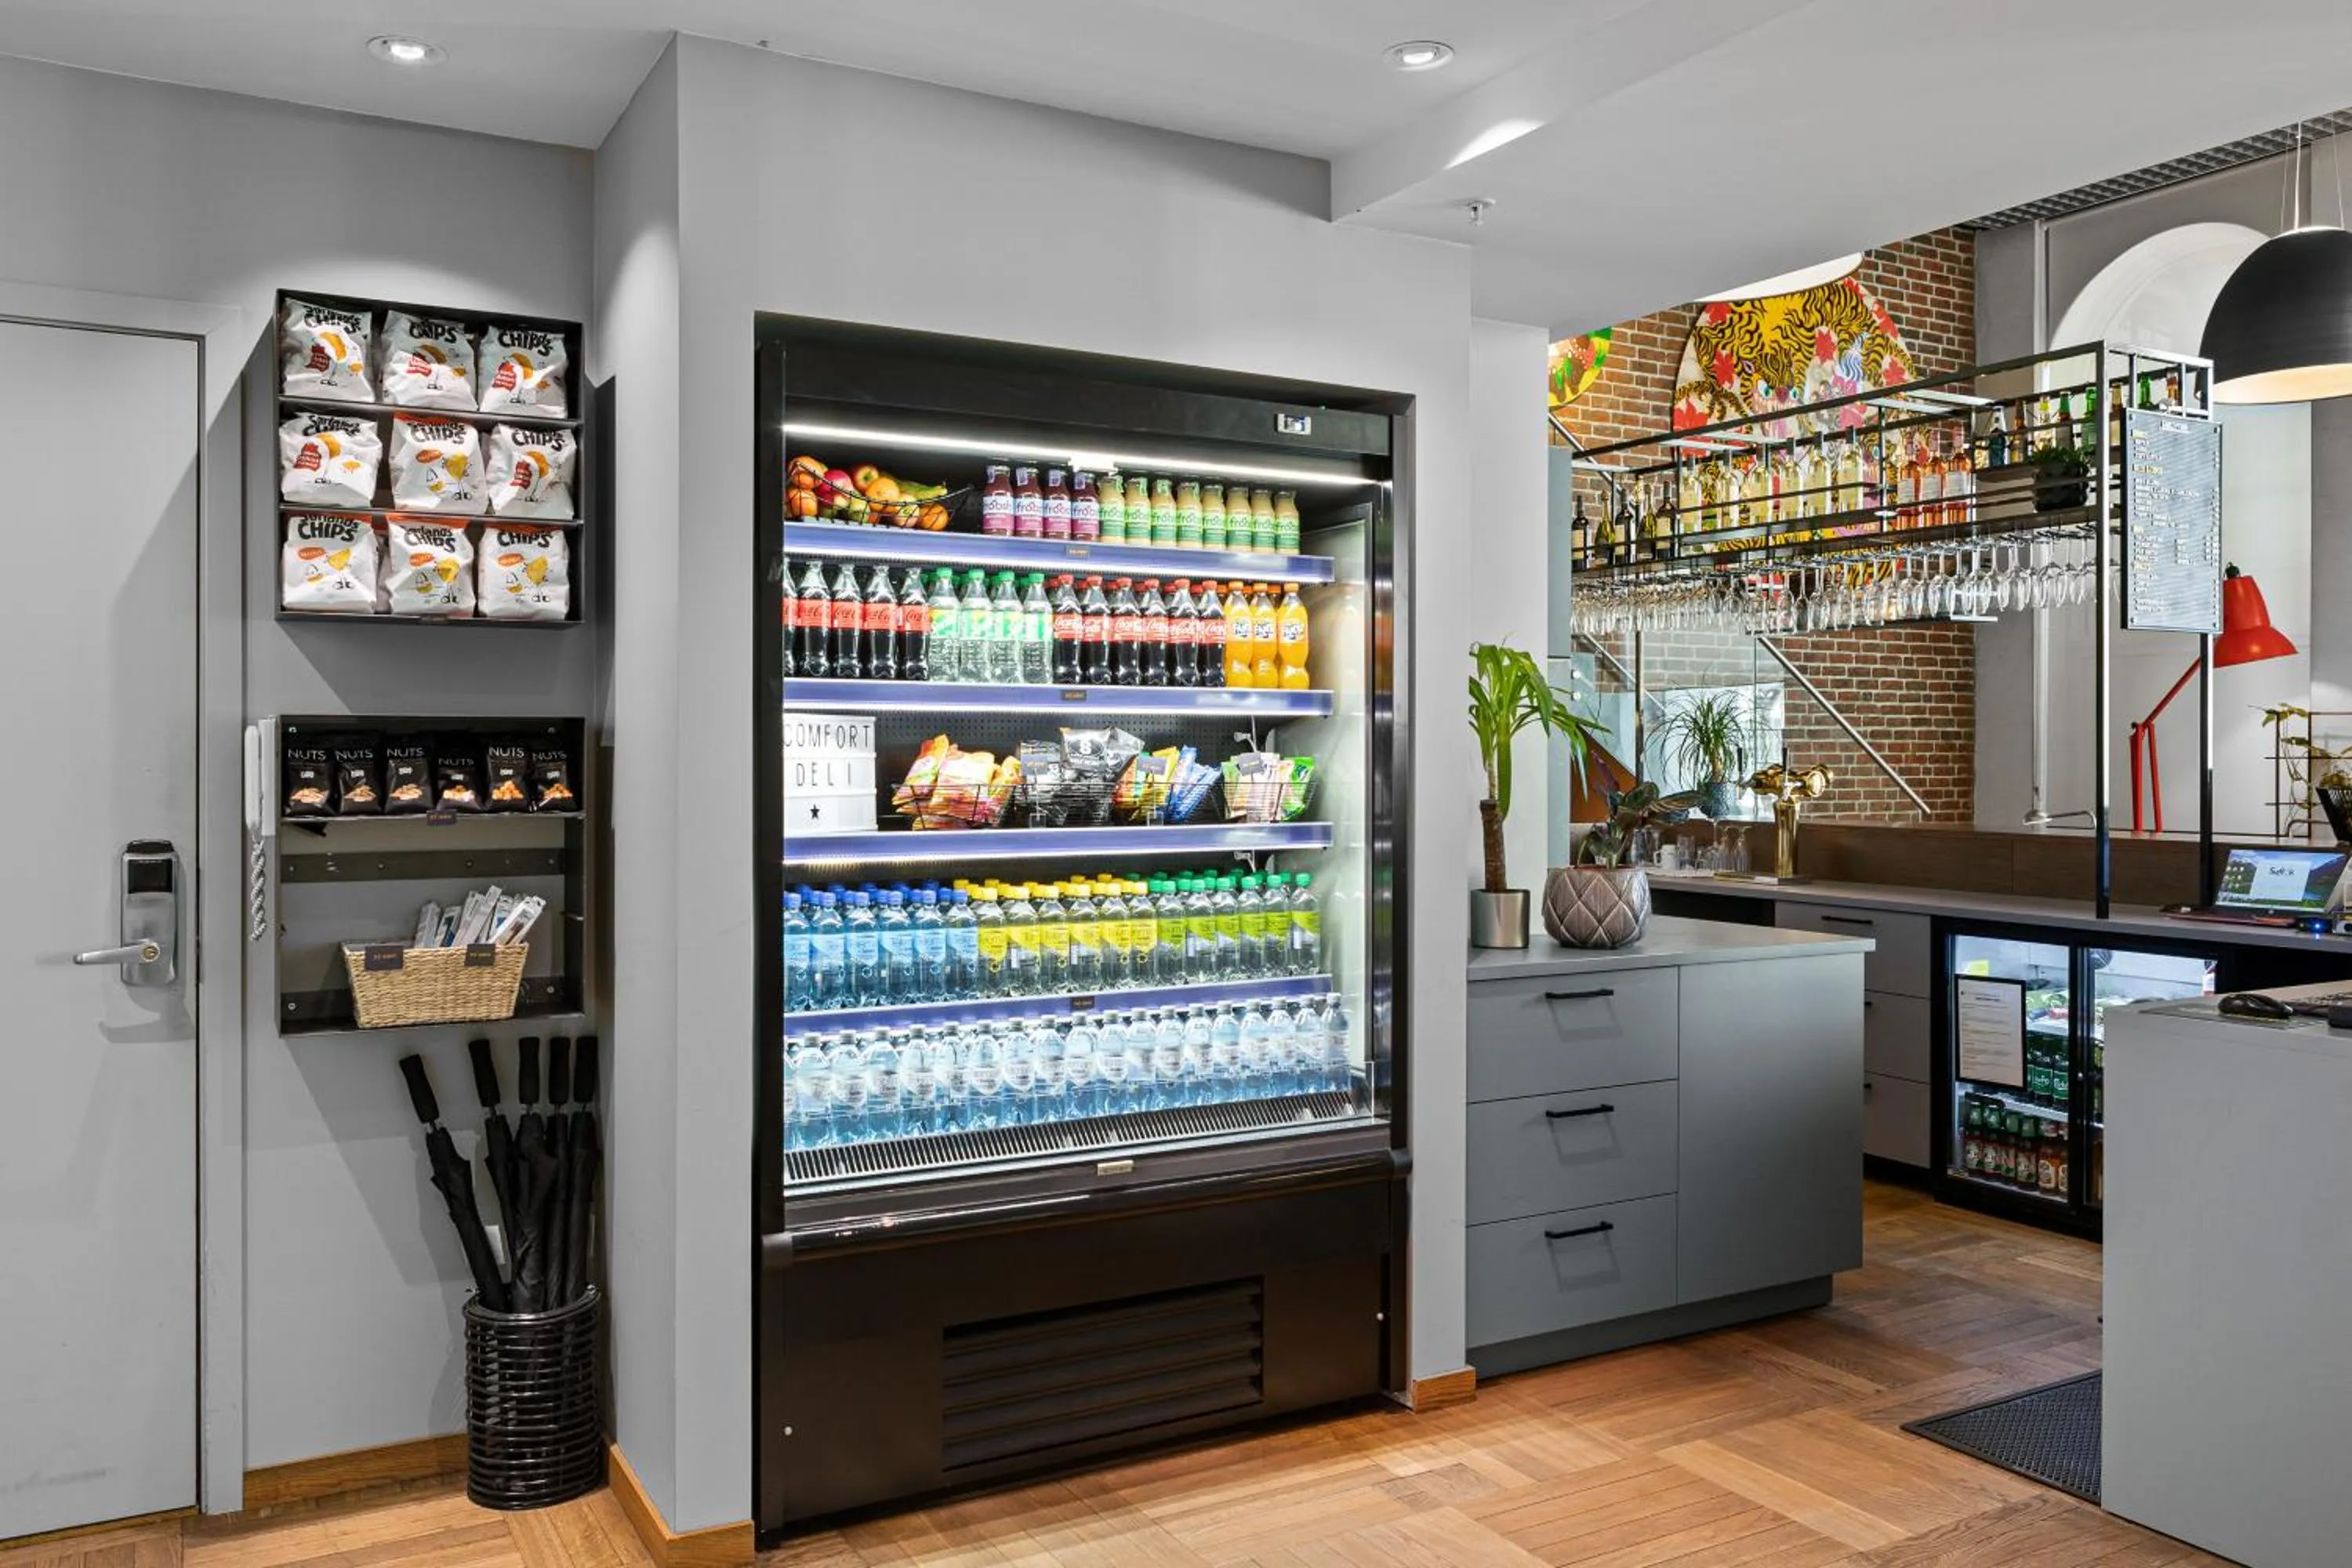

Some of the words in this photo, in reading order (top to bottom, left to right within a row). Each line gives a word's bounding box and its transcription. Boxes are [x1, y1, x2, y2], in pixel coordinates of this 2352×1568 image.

[498, 330, 554, 357] CHIPS
[410, 426, 467, 445] CHIPS
[511, 430, 565, 452] CHIPS
[298, 521, 358, 542] CHIPS
[497, 531, 554, 548] CHIPS
[404, 532, 456, 554] CHIPS
[783, 723, 871, 750] COMFORT
[288, 749, 326, 760] NUTS
[336, 750, 374, 760] NUTS
[387, 746, 424, 757] NUTS
[488, 746, 524, 758] NUTS
[532, 750, 568, 760] NUTS
[796, 761, 851, 786] DELI
